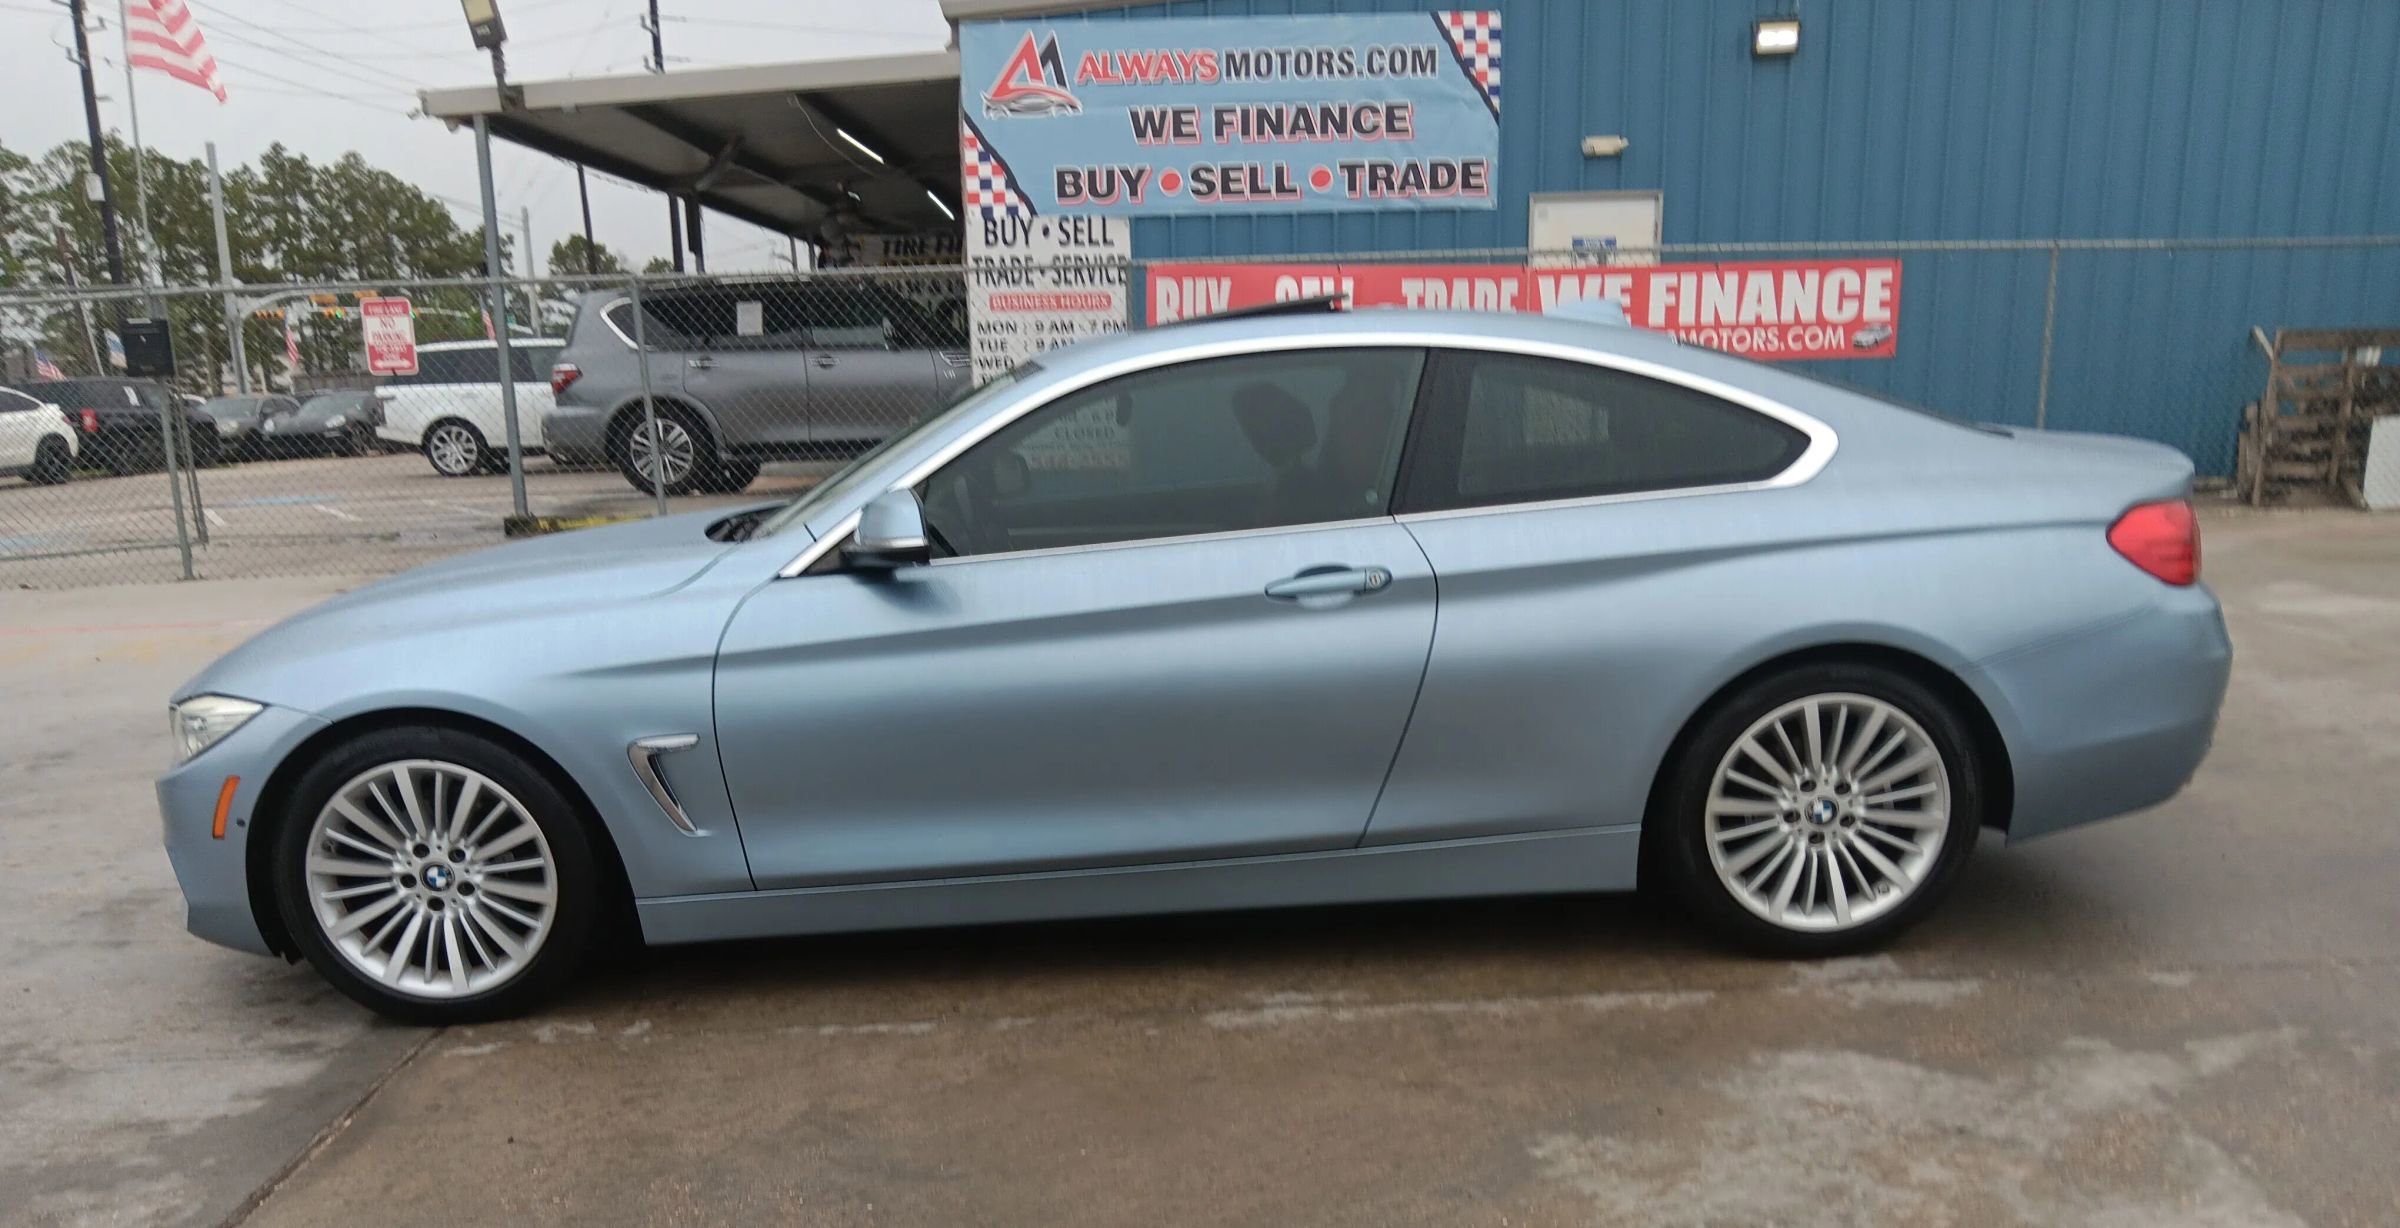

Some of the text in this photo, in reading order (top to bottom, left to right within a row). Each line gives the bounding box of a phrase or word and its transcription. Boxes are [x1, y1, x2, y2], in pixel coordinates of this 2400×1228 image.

[1127, 100, 1414, 144] WE FINANCE
[1055, 156, 1489, 205] BUY SELL TRADE
[984, 214, 1115, 248] BUY SELL
[972, 254, 1035, 288] TRADE
[1052, 252, 1128, 288] SERVICE
[991, 292, 1109, 311] BUSINESS HOURS
[1648, 267, 1893, 328] FINANCE
[976, 319, 1018, 335] MON
[1049, 318, 1075, 335] AM
[977, 337, 1008, 352] TUE
